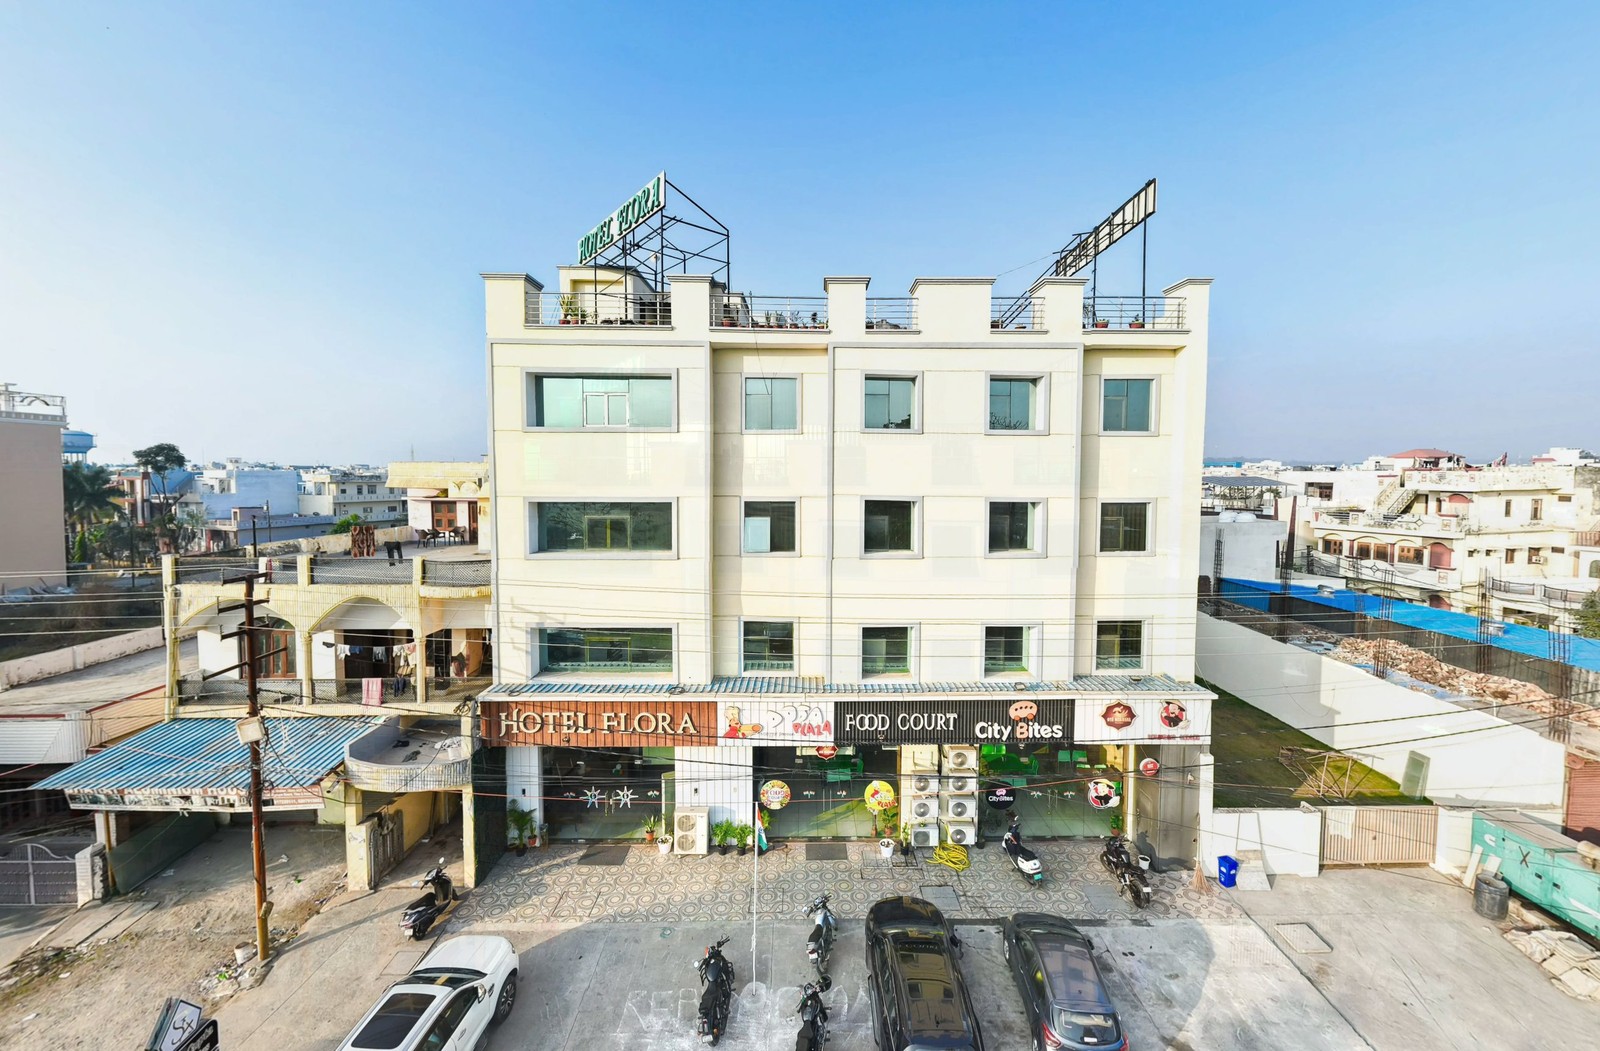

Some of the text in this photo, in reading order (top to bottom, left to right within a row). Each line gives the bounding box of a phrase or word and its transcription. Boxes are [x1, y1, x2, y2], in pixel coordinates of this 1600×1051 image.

[579, 176, 661, 265] HOTEL FLORA
[499, 708, 700, 737] HOTEL FLORA
[792, 719, 832, 737] PLAZA
[845, 712, 958, 731] FOOD COURT
[975, 721, 1063, 741] City Bites
